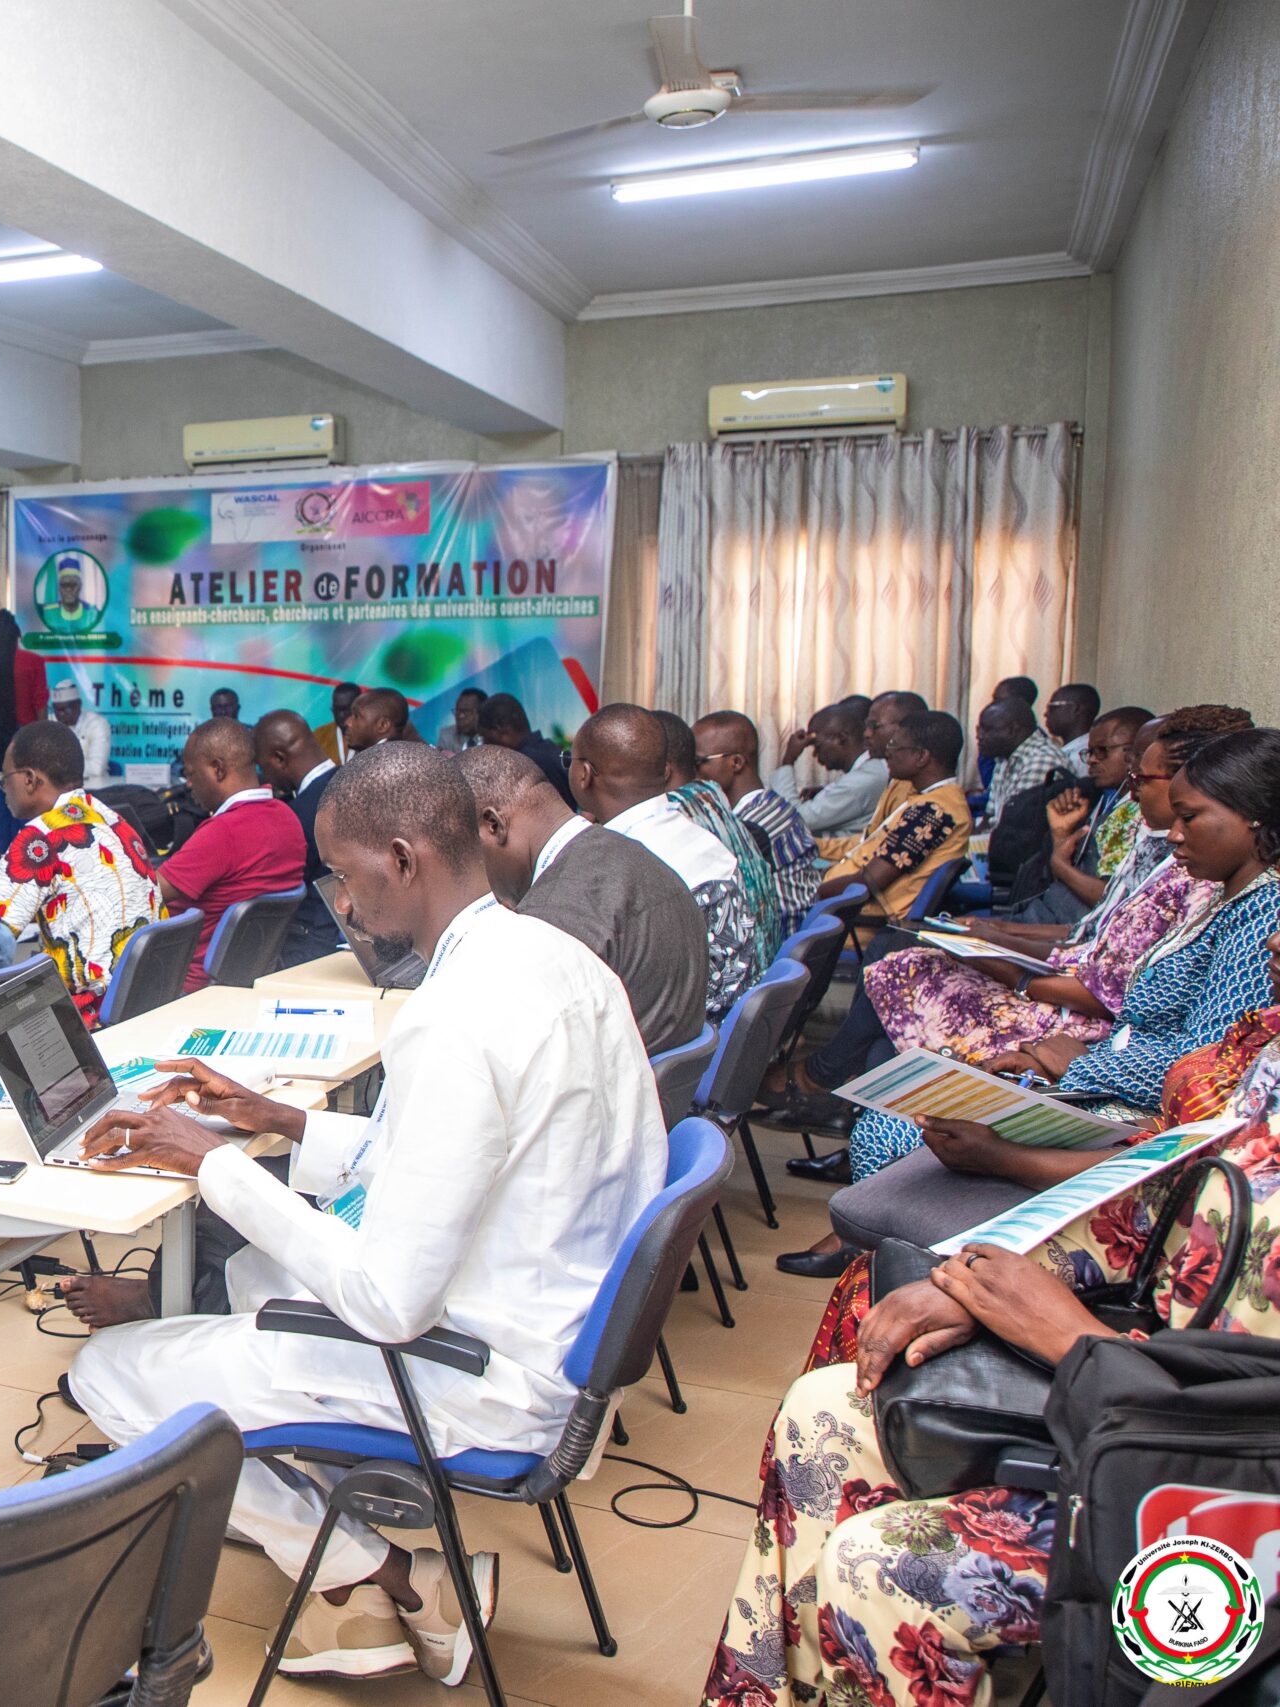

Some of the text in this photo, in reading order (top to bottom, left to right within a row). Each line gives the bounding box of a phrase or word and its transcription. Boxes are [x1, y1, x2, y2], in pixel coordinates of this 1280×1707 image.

[234, 494, 280, 504] WASCAL
[352, 509, 404, 524] AICCRA
[169, 558, 556, 604] ATELIER de FORMATION
[130, 596, 595, 628] Des enseignants-chercheurs, chercheurs et partenaires des universités ouest-africaines
[92, 681, 185, 708] Thème
